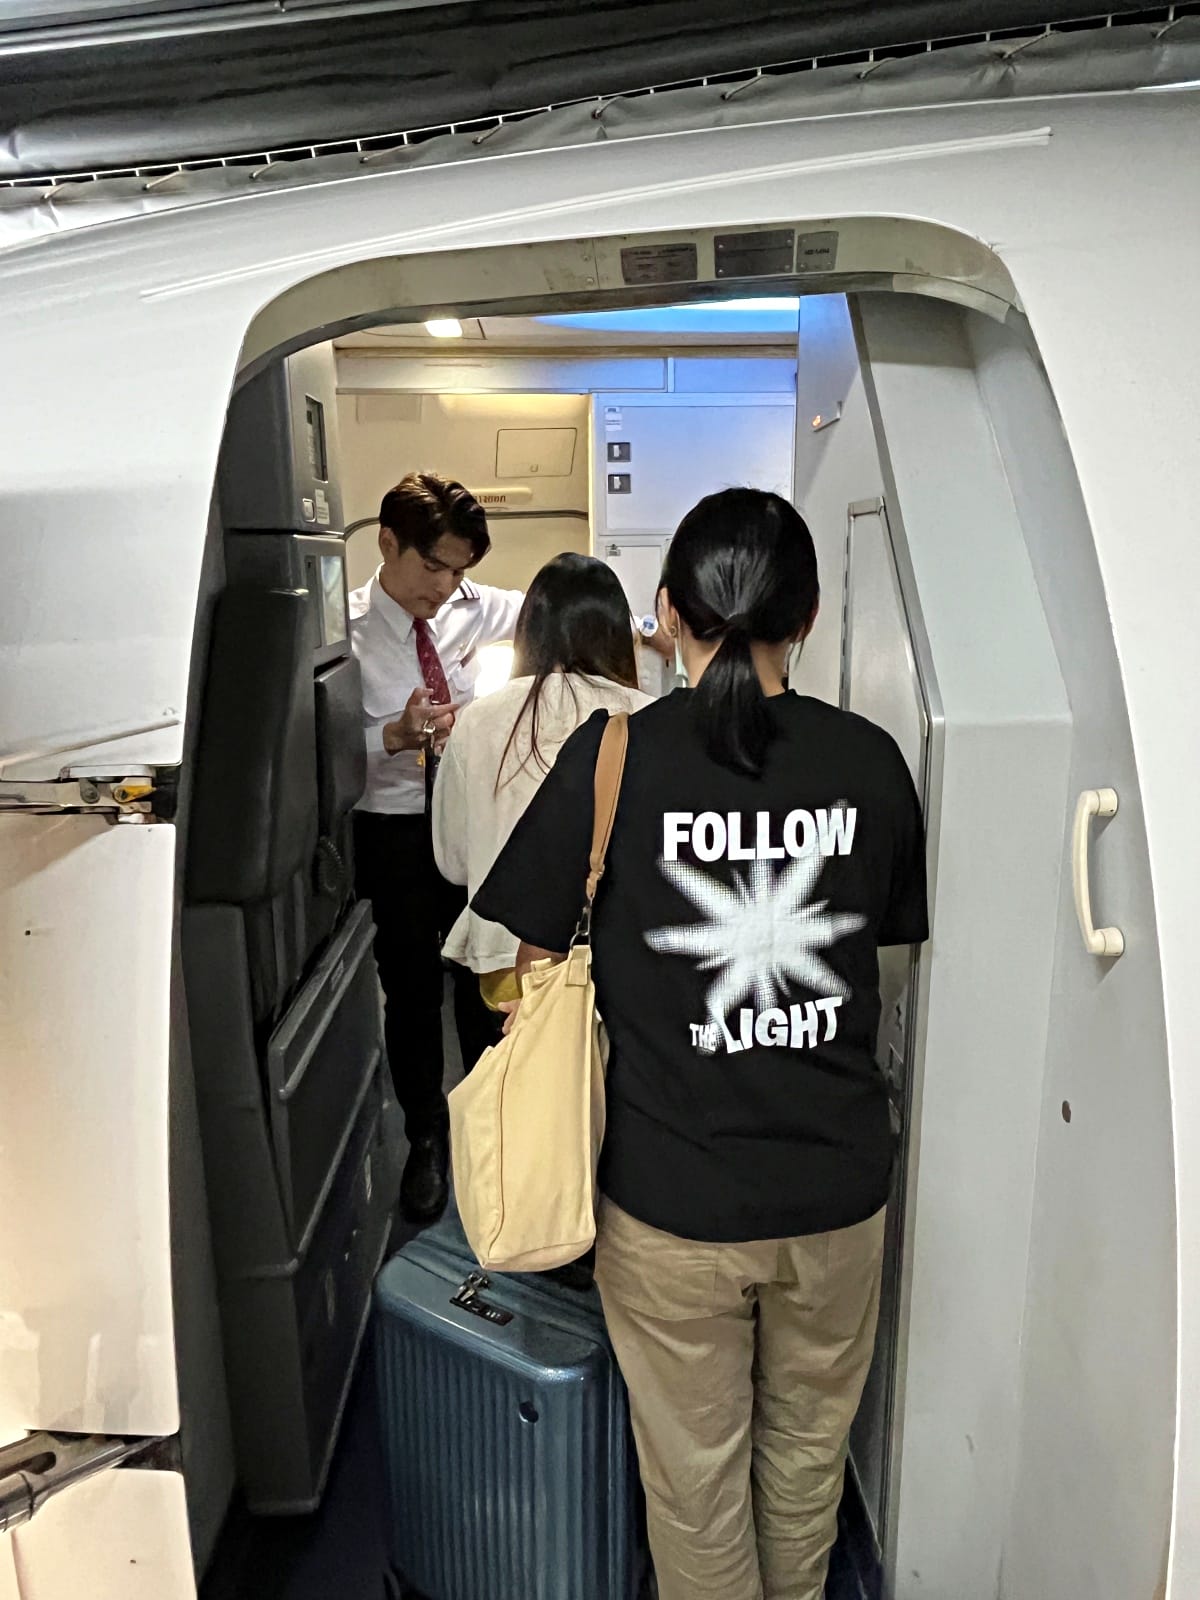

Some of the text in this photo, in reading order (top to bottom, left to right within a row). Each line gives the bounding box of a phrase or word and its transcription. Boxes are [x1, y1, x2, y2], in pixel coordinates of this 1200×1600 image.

[663, 807, 857, 862] FOLLOW
[689, 996, 843, 1054] THE LIGHT
